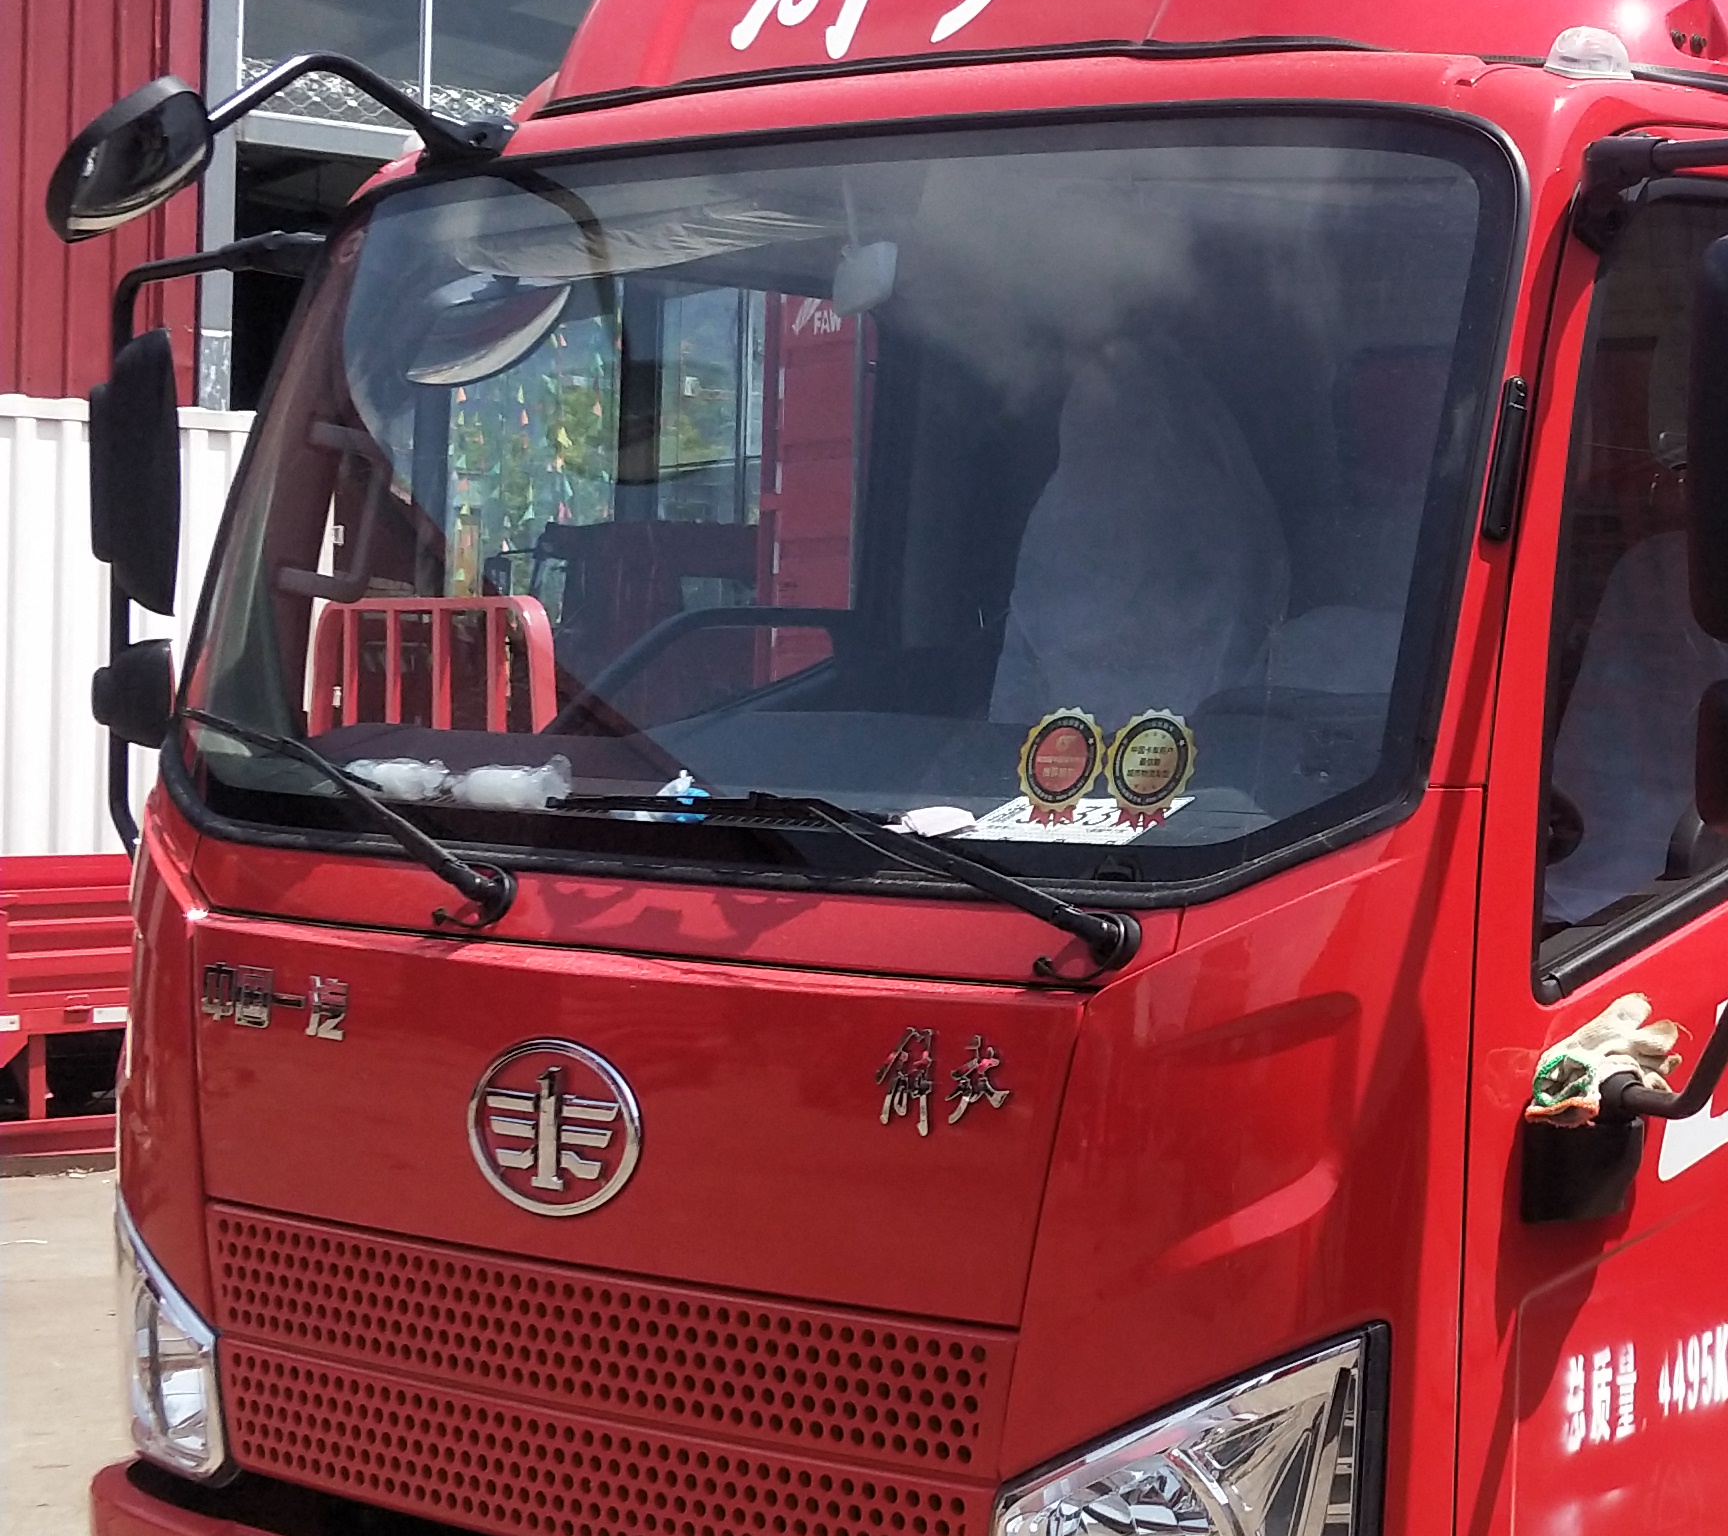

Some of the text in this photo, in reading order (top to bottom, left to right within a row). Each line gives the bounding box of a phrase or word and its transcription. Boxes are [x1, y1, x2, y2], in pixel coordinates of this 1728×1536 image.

[813, 309, 842, 335] FAW
[201, 962, 349, 1041] 中国一汽
